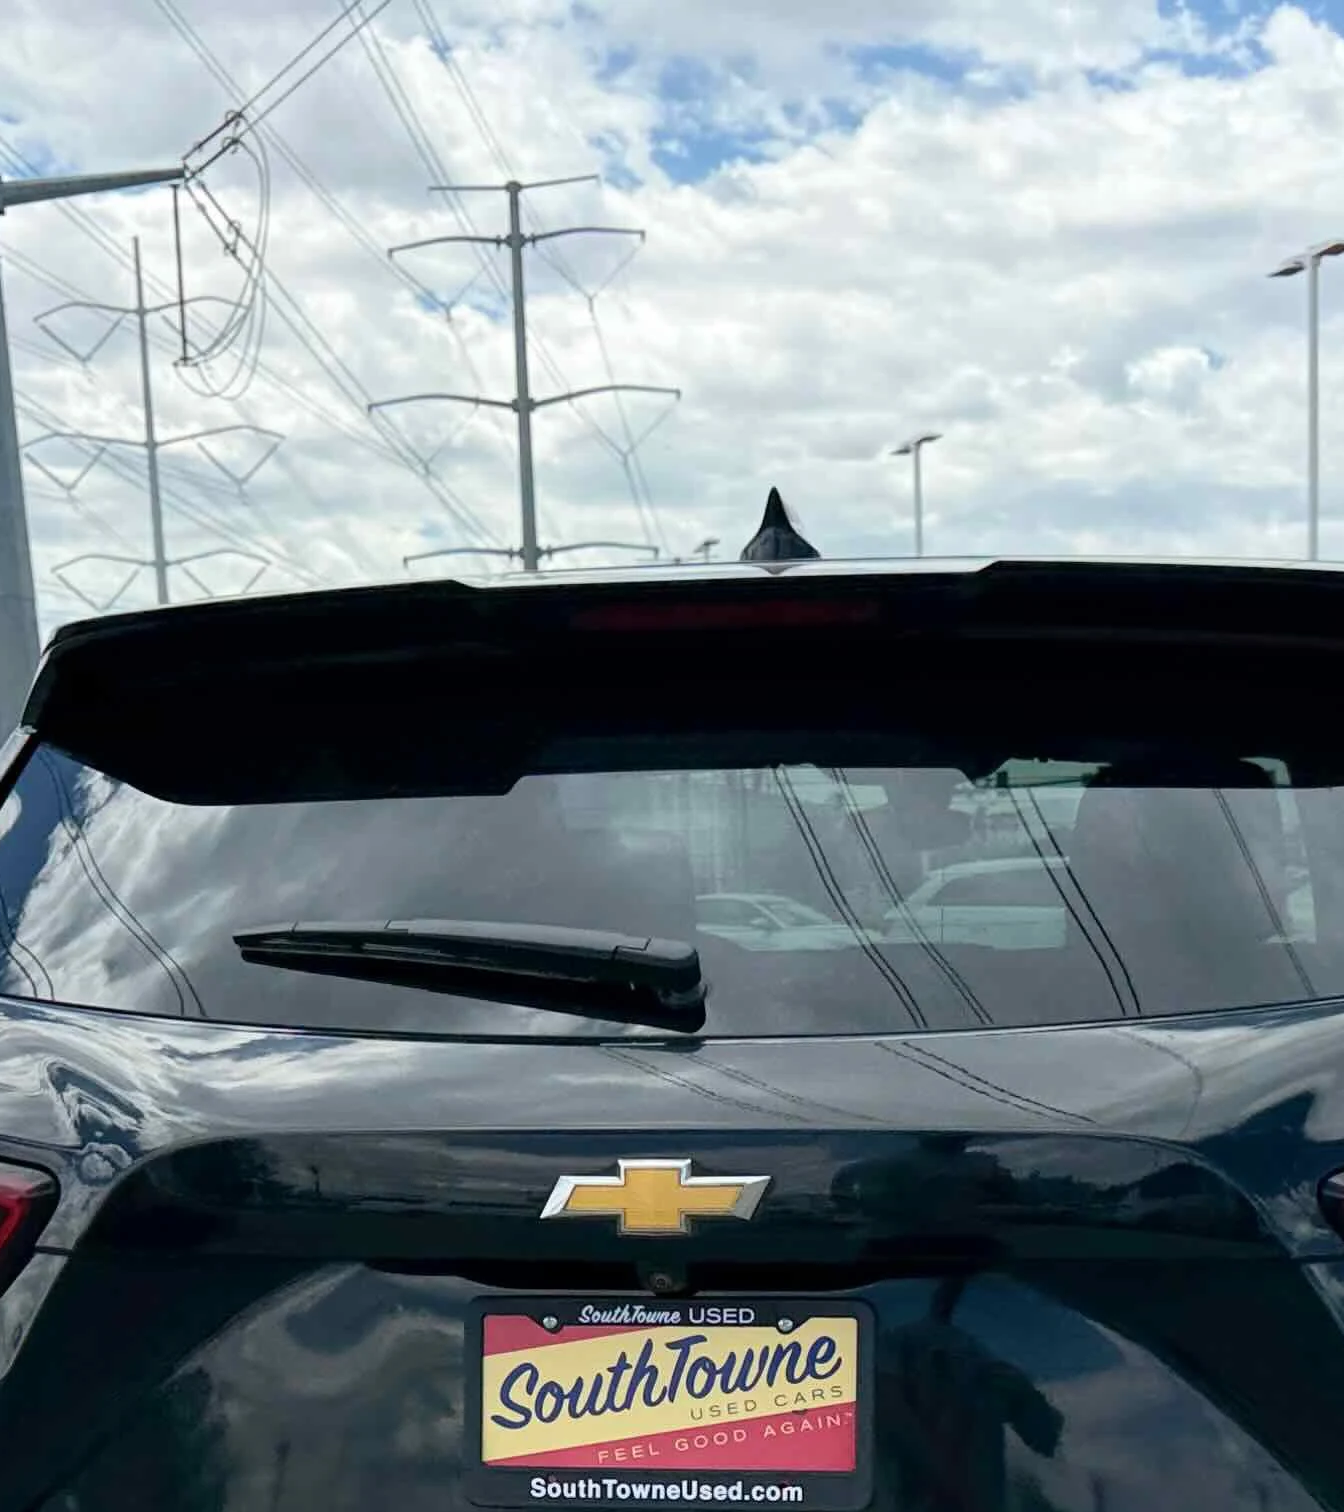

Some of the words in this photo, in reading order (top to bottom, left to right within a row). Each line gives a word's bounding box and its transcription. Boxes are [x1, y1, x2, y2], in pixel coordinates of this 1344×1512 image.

[578, 1304, 682, 1325] SouthTowne
[688, 1307, 755, 1324] USED
[491, 1334, 842, 1429] SouthTowne
[690, 1399, 757, 1421] USED
[774, 1385, 844, 1407] CARS
[597, 1443, 660, 1464] FEEL
[674, 1429, 747, 1452] GOOD
[530, 1477, 803, 1501] SouthTowneUsed.com
